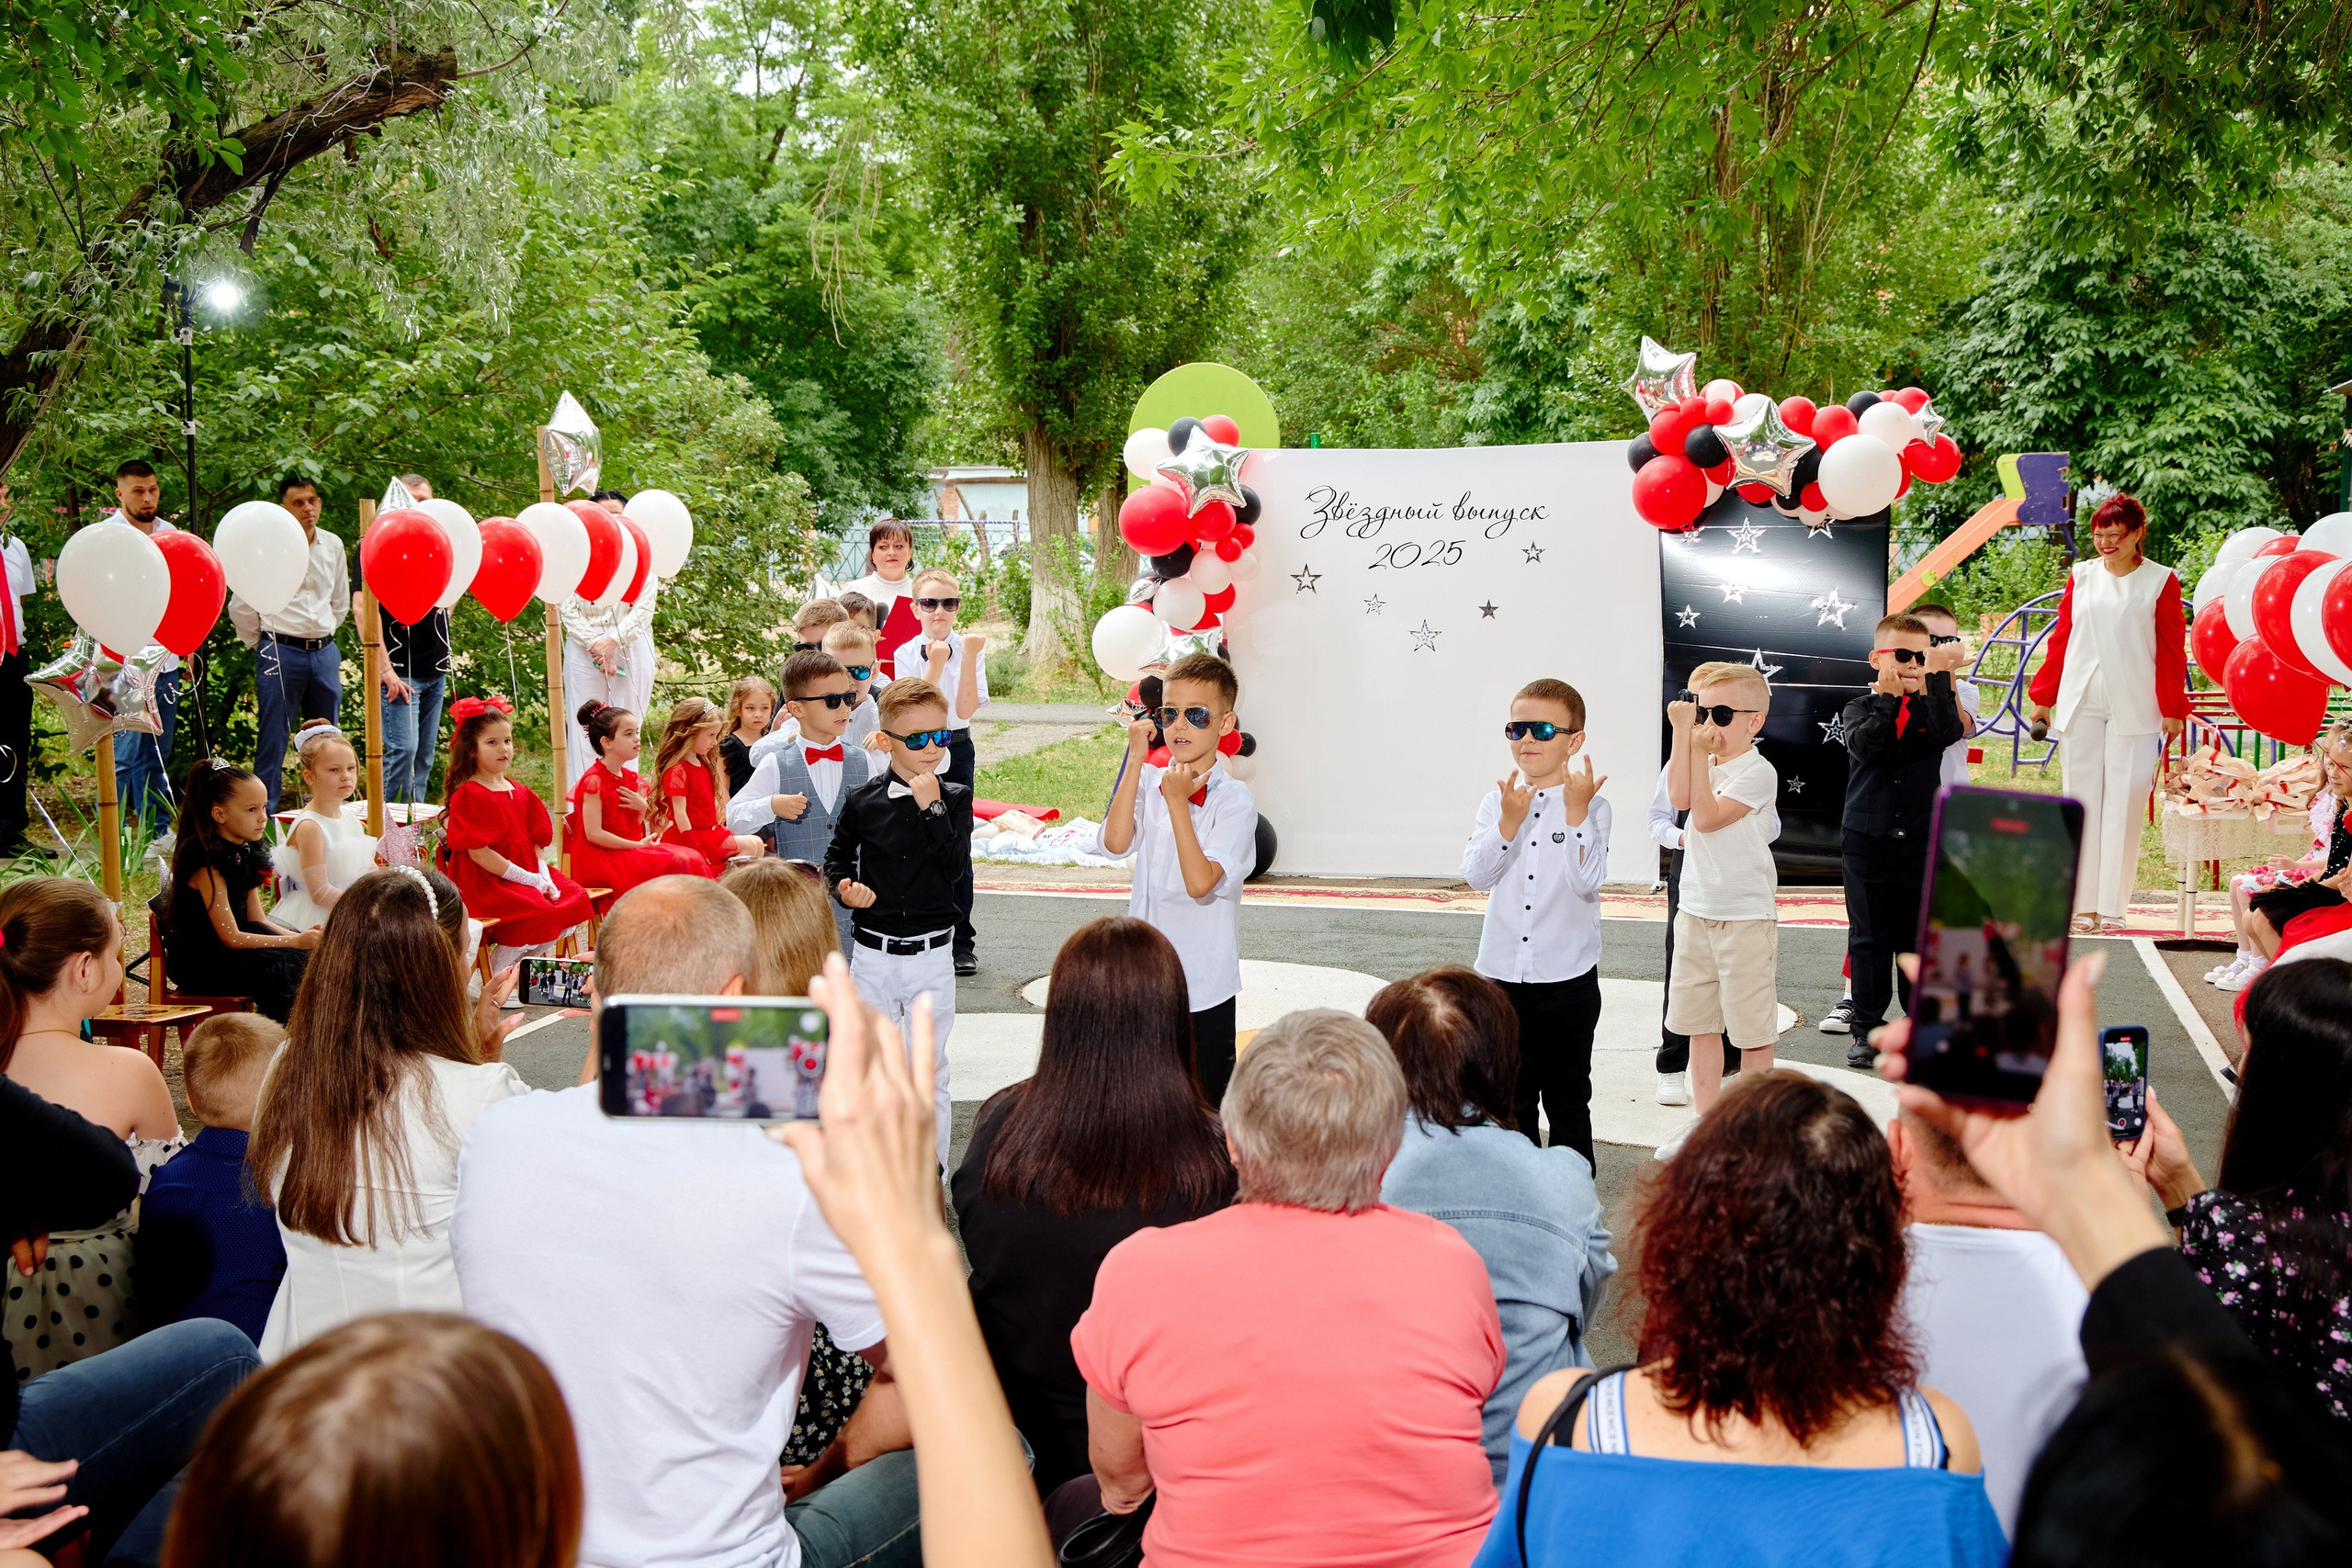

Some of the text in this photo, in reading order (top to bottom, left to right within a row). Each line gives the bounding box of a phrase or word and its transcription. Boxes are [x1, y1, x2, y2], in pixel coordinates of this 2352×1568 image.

[1300, 485, 1550, 539] Звёздный выпуск
[1368, 540, 1466, 570] 2025
